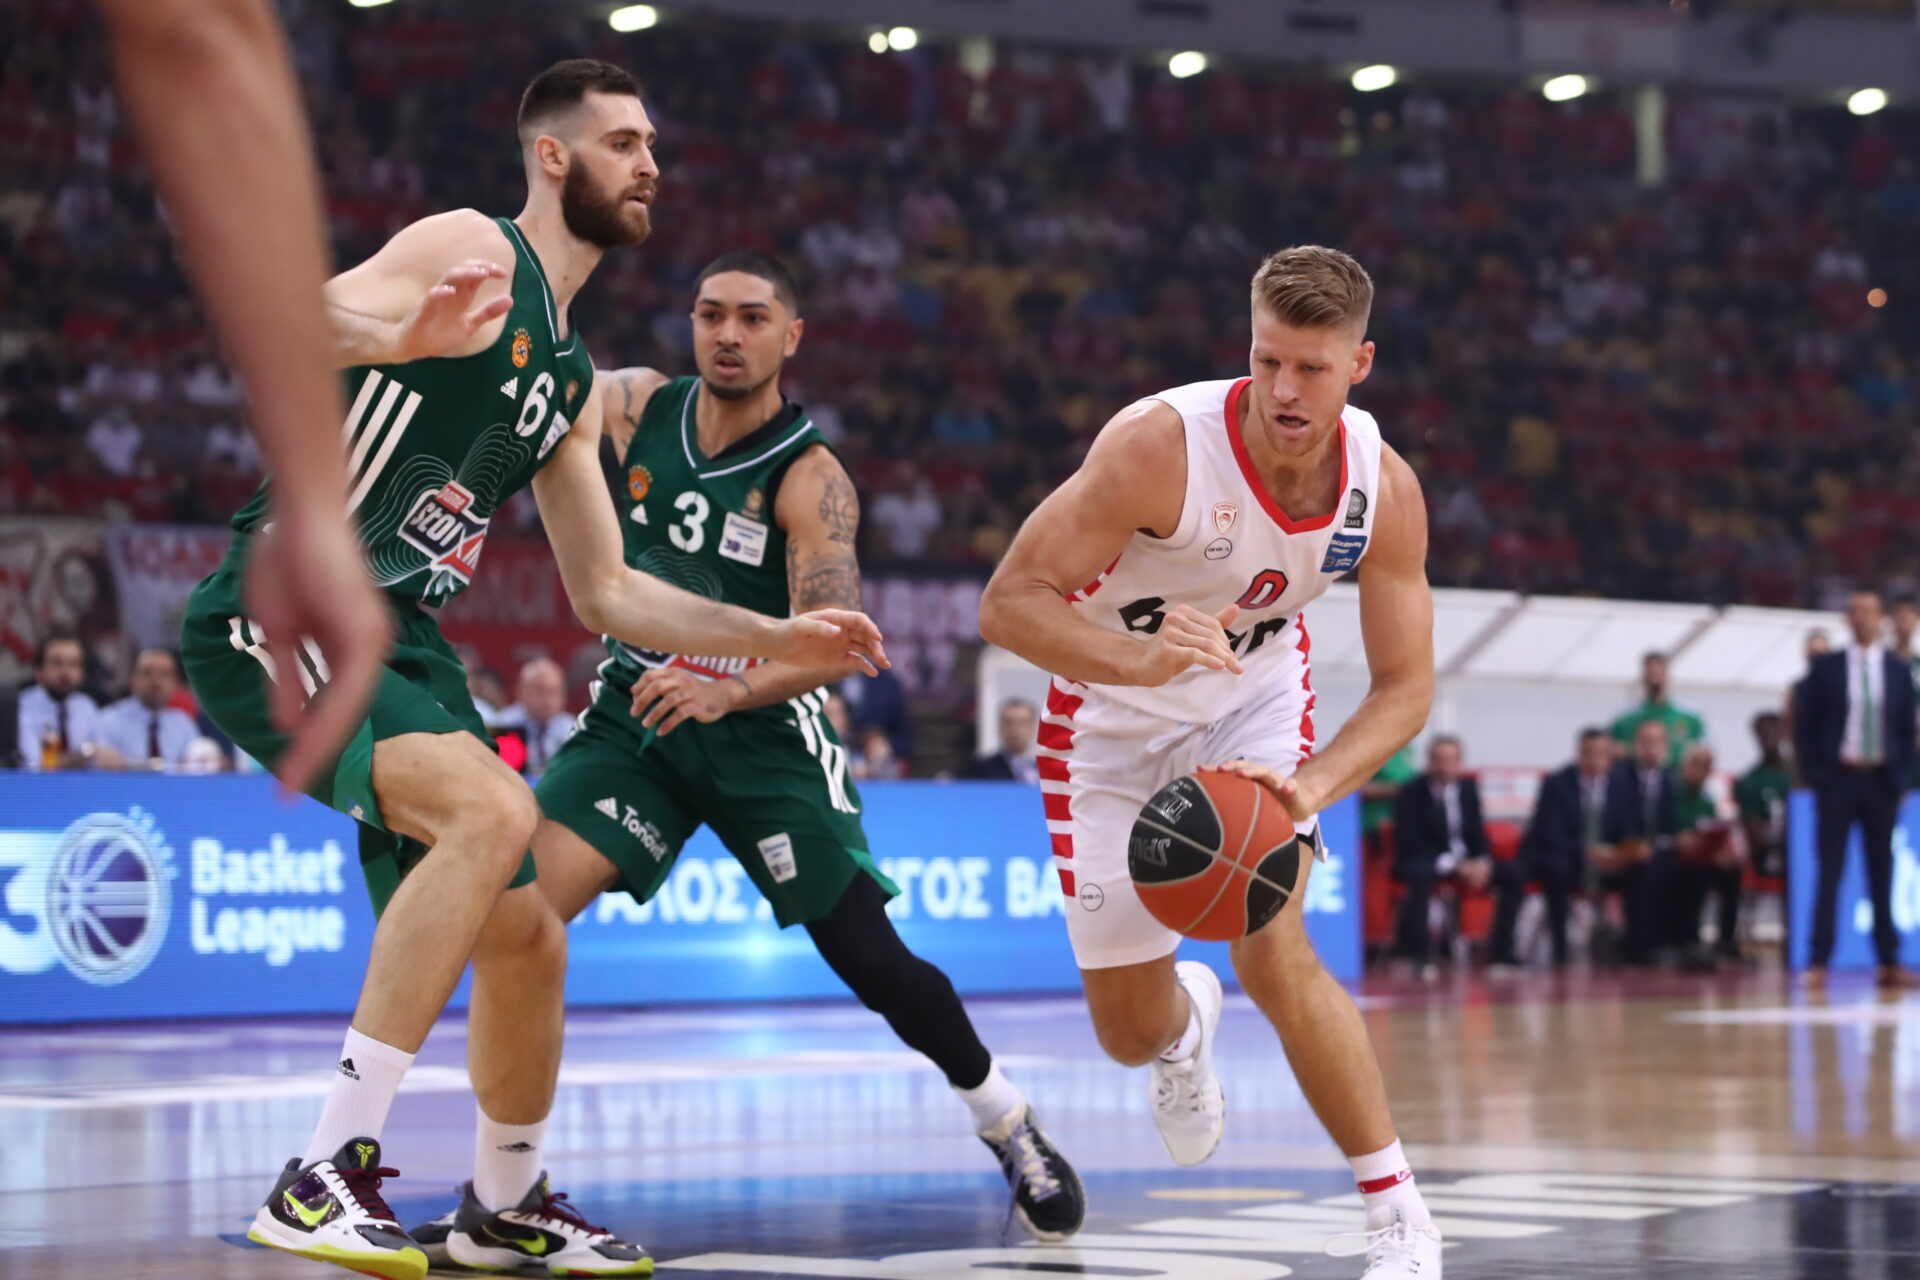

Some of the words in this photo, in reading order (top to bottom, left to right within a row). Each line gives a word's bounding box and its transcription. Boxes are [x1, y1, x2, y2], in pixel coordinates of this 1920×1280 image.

[515, 371, 555, 437] 6
[668, 490, 710, 553] 3
[1234, 568, 1289, 610] 0
[191, 833, 345, 895] Basket
[191, 897, 346, 966] League
